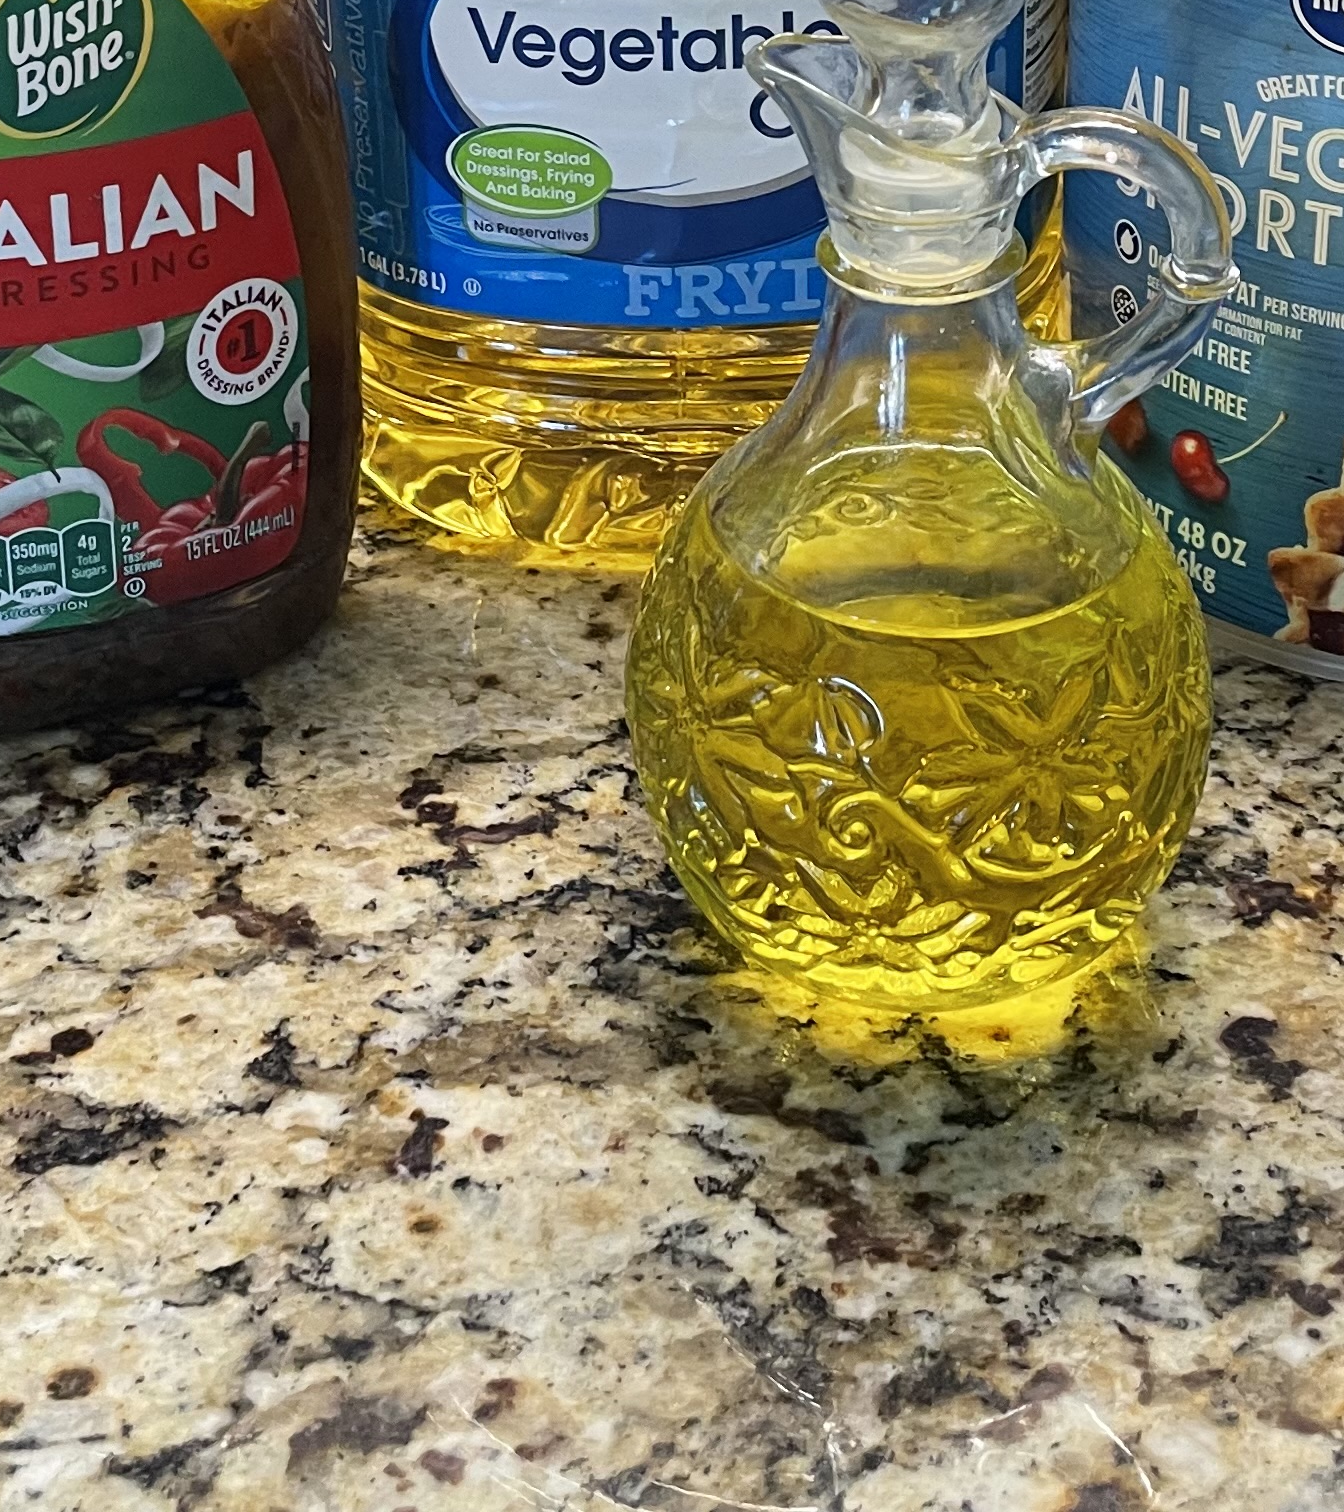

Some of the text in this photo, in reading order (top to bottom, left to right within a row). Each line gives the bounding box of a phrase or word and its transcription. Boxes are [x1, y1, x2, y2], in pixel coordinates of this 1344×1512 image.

[15, 29, 125, 119] Bone
[1256, 74, 1320, 103] GREAT
[468, 142, 591, 166] Great For Salad
[466, 160, 595, 187] Dressings, Frying
[485, 180, 576, 204] And Baking
[473, 219, 589, 243] No Preservatives
[368, 248, 447, 295] GAL (3.78 L)
[622, 264, 821, 320] FRYI
[201, 285, 283, 332] ITALIAN
[1262, 294, 1289, 318] PER
[1224, 322, 1266, 346] CONTENT
[1263, 317, 1303, 342] FOR FAT
[1207, 338, 1252, 375] FREE
[197, 358, 255, 396] DRESSING
[1204, 384, 1249, 422] FREE
[76, 534, 98, 554] 4g
[121, 535, 133, 552] 2
[185, 504, 296, 561] 15 FL OZ (444 mL)
[1176, 516, 1249, 569] 48 OZ
[10, 540, 58, 562] 350mg
[77, 552, 102, 567] Total
[16, 560, 57, 575] Sodium
[71, 563, 108, 580] Sugars
[123, 559, 163, 576] SERVING
[42, 584, 58, 598] DV
[0, 599, 89, 622] SUGGESTION
